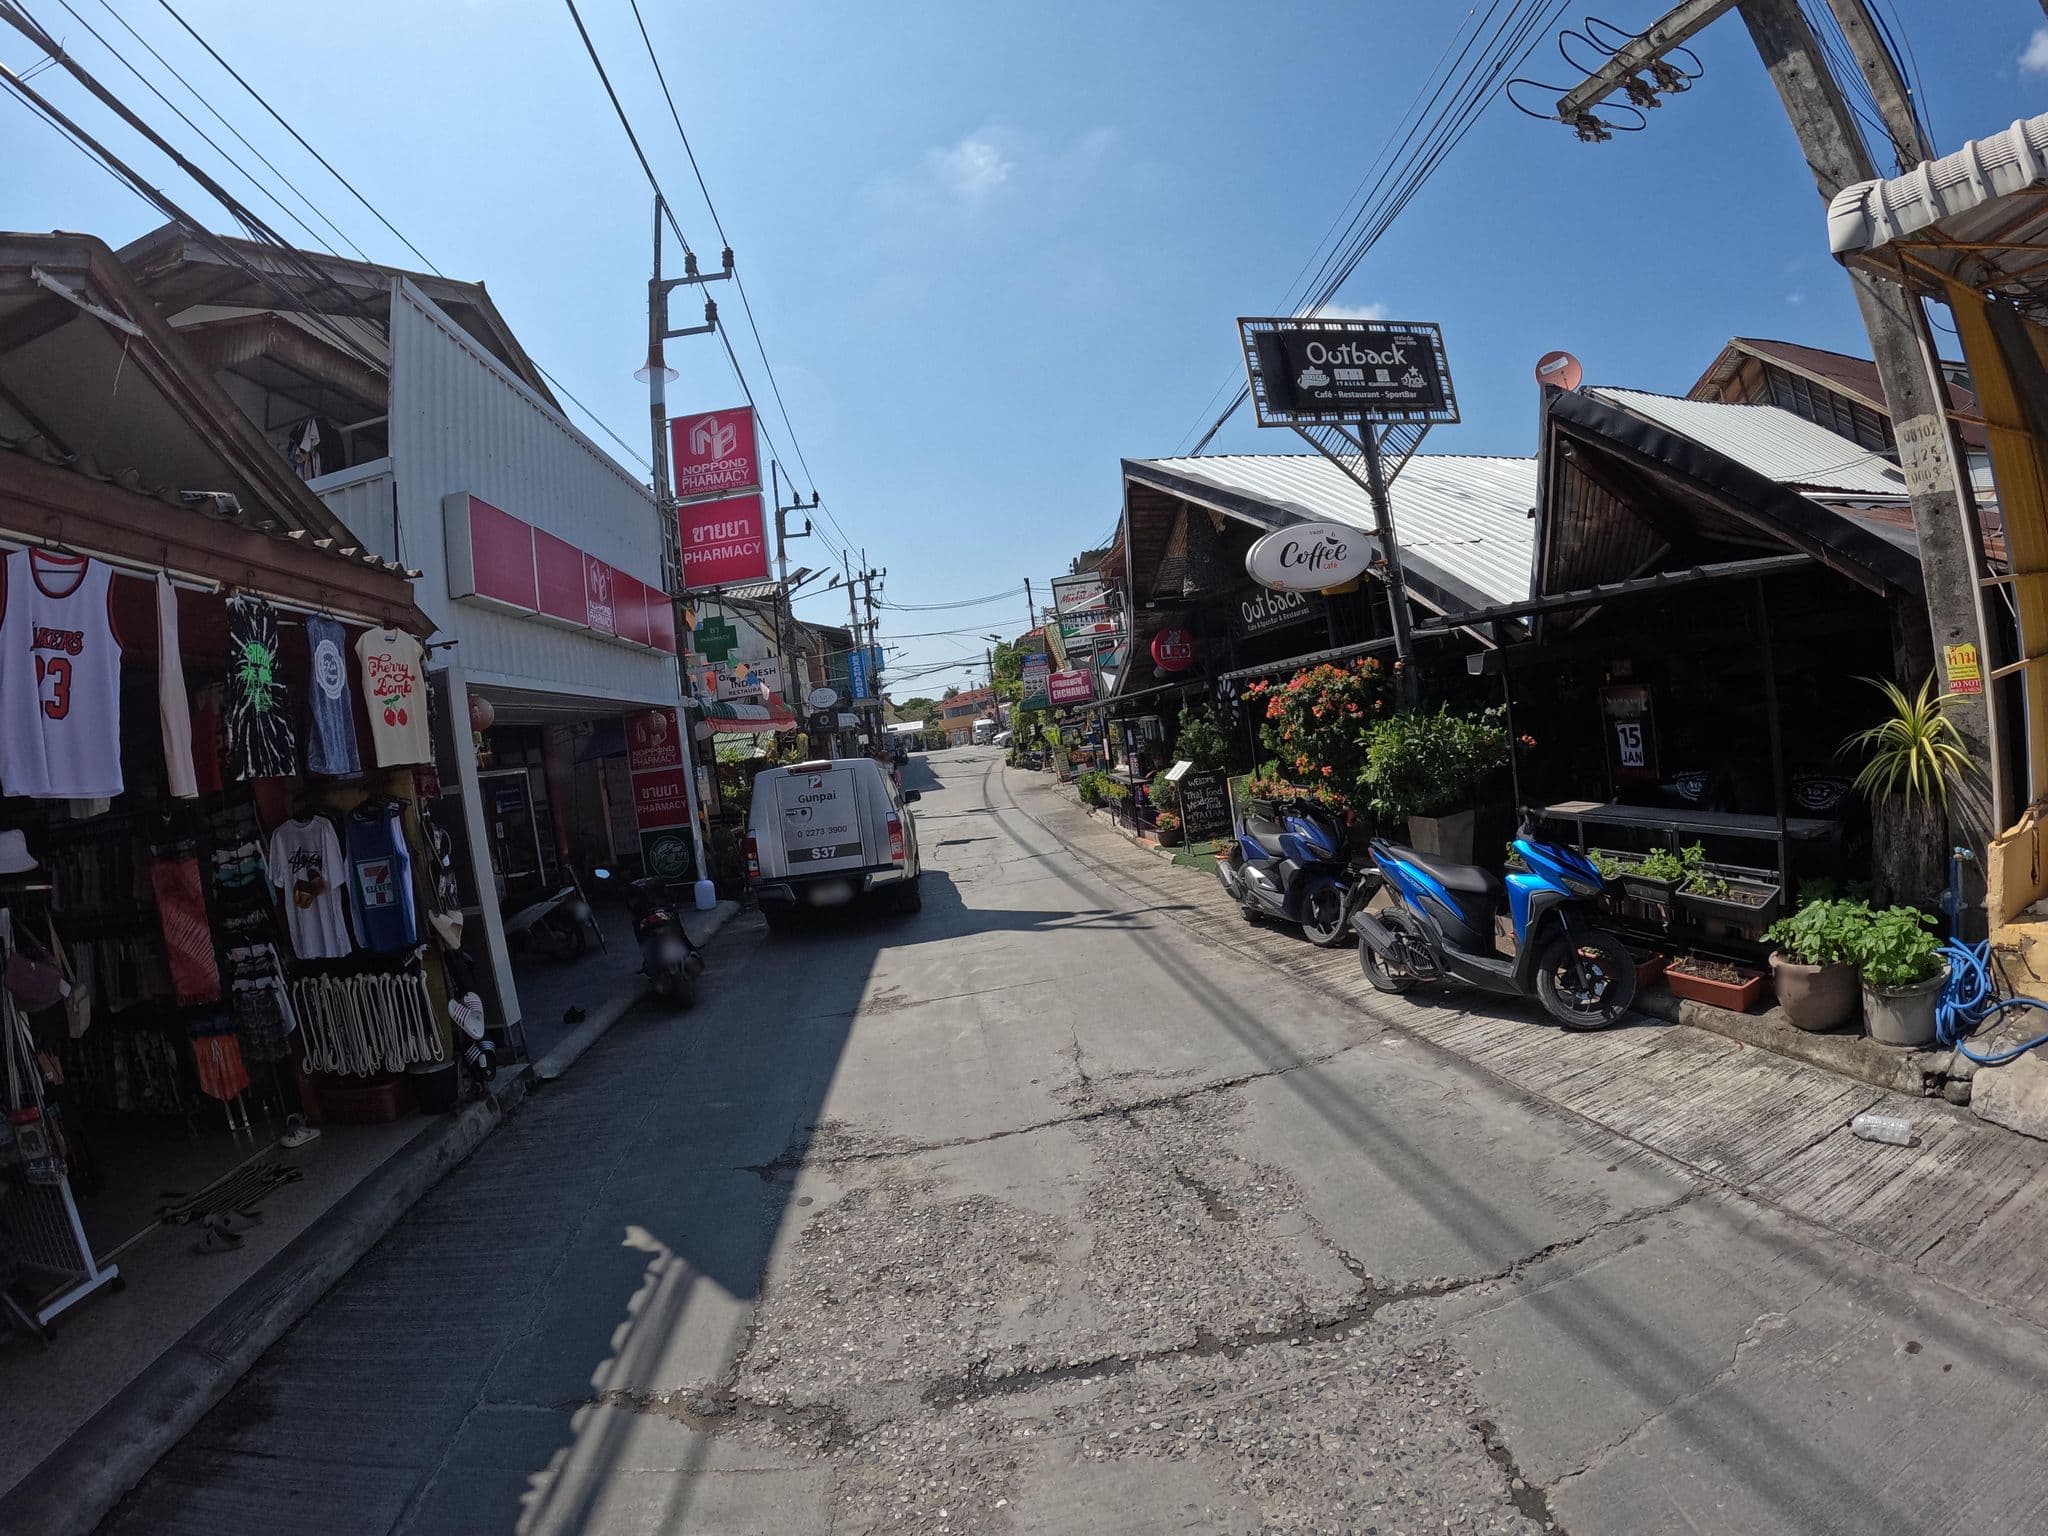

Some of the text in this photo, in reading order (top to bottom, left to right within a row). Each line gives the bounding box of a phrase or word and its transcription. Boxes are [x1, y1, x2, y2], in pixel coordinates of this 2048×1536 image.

[1306, 341, 1407, 365] Outback
[1315, 390, 1333, 399] Café
[1338, 390, 1380, 398] Restaurant
[682, 457, 747, 476] NOPPOND
[681, 468, 750, 490] PHARMACY
[692, 519, 750, 543] ขายยา
[684, 541, 762, 565] PHARMACY
[1280, 541, 1348, 572] Coffee
[367, 653, 416, 683] Cherry
[373, 674, 412, 697] Bomb
[1053, 685, 1091, 700] EXCHANGE
[1950, 681, 1961, 689] DO
[1619, 726, 1641, 748] 15
[632, 745, 675, 758] NOPPOND
[1623, 751, 1643, 764] JAN
[632, 753, 677, 766] PHARMACY
[797, 790, 837, 804] Gunpai
[637, 800, 687, 814] PHARMACY
[806, 827, 825, 837] 2273
[828, 825, 848, 835] 3900
[811, 846, 837, 860] S37
